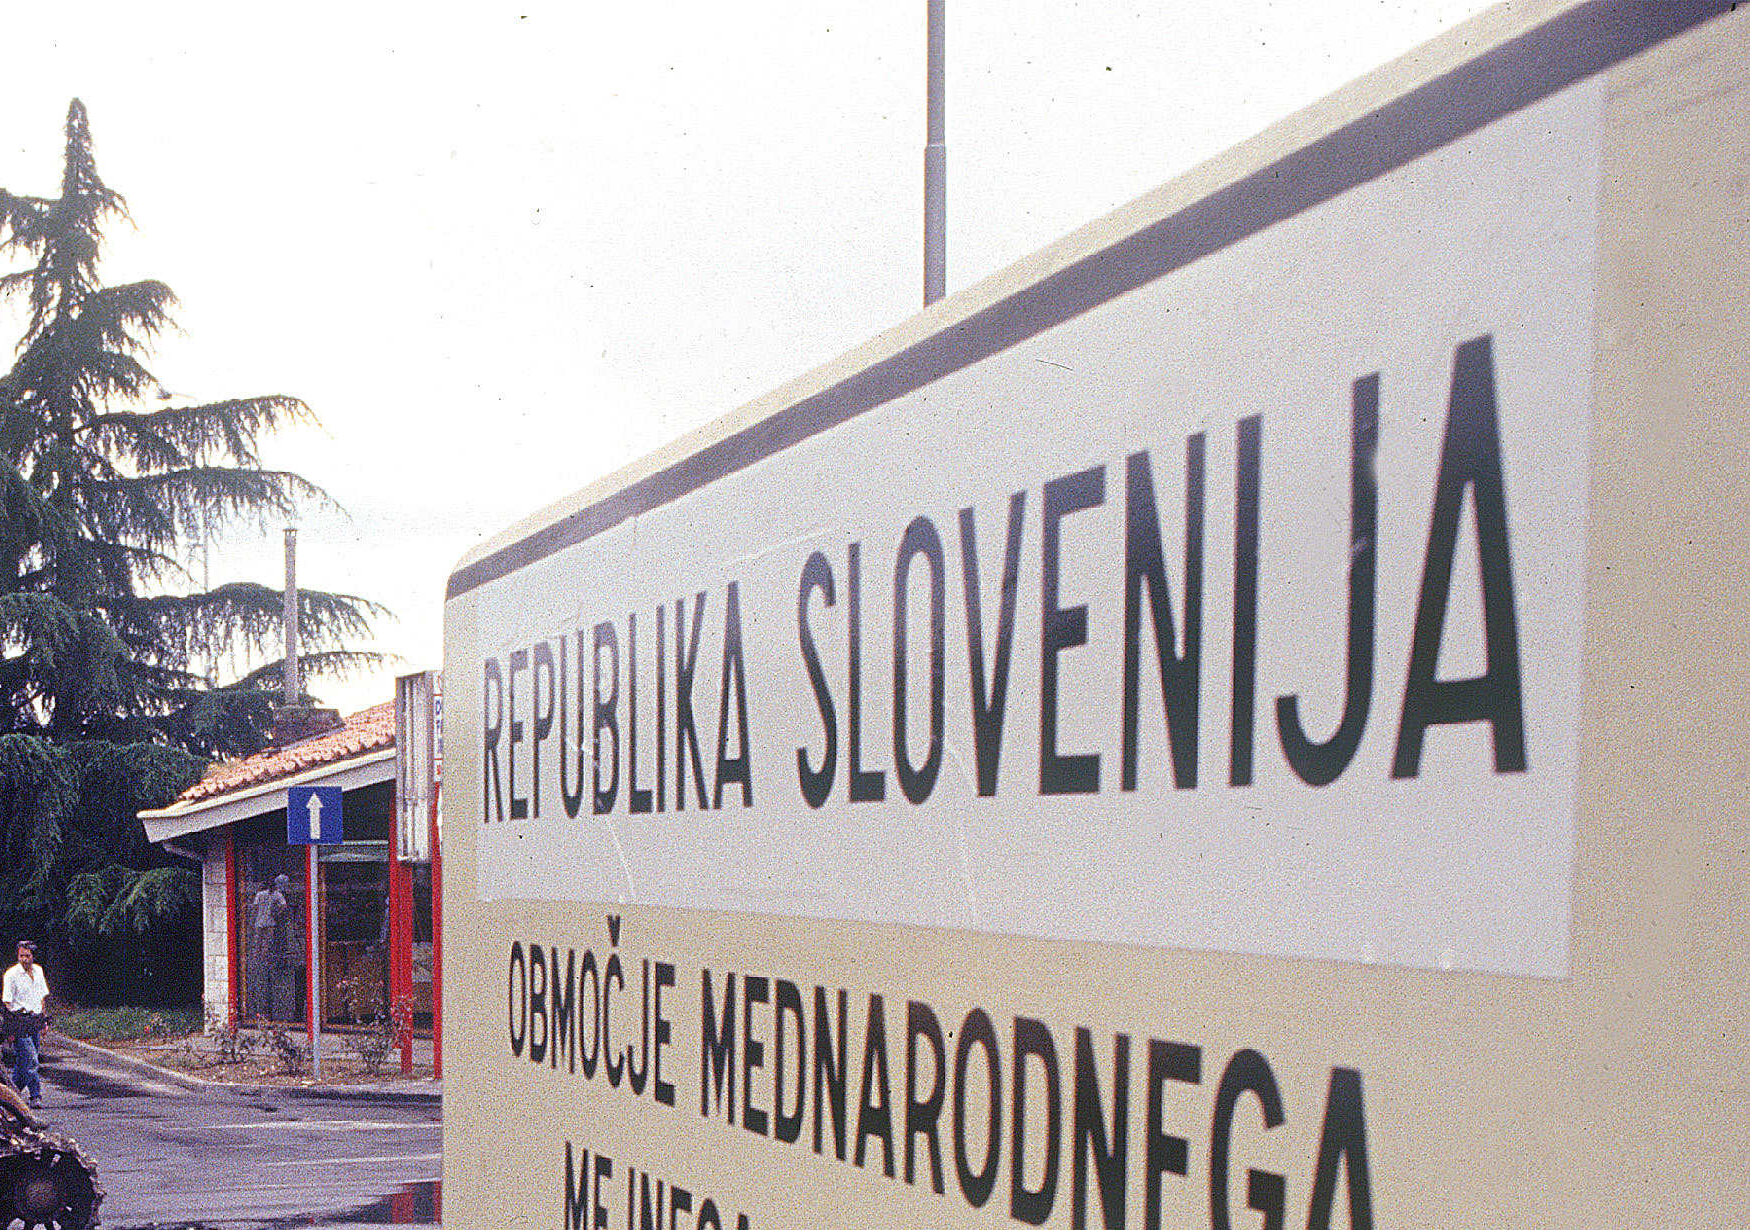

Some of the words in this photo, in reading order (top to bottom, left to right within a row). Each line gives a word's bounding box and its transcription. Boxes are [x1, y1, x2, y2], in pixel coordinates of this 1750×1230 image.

[481, 579, 754, 825] REPUBLIKA
[796, 332, 1528, 812] SLOVENIJA
[508, 914, 677, 1109] OBMOČJE
